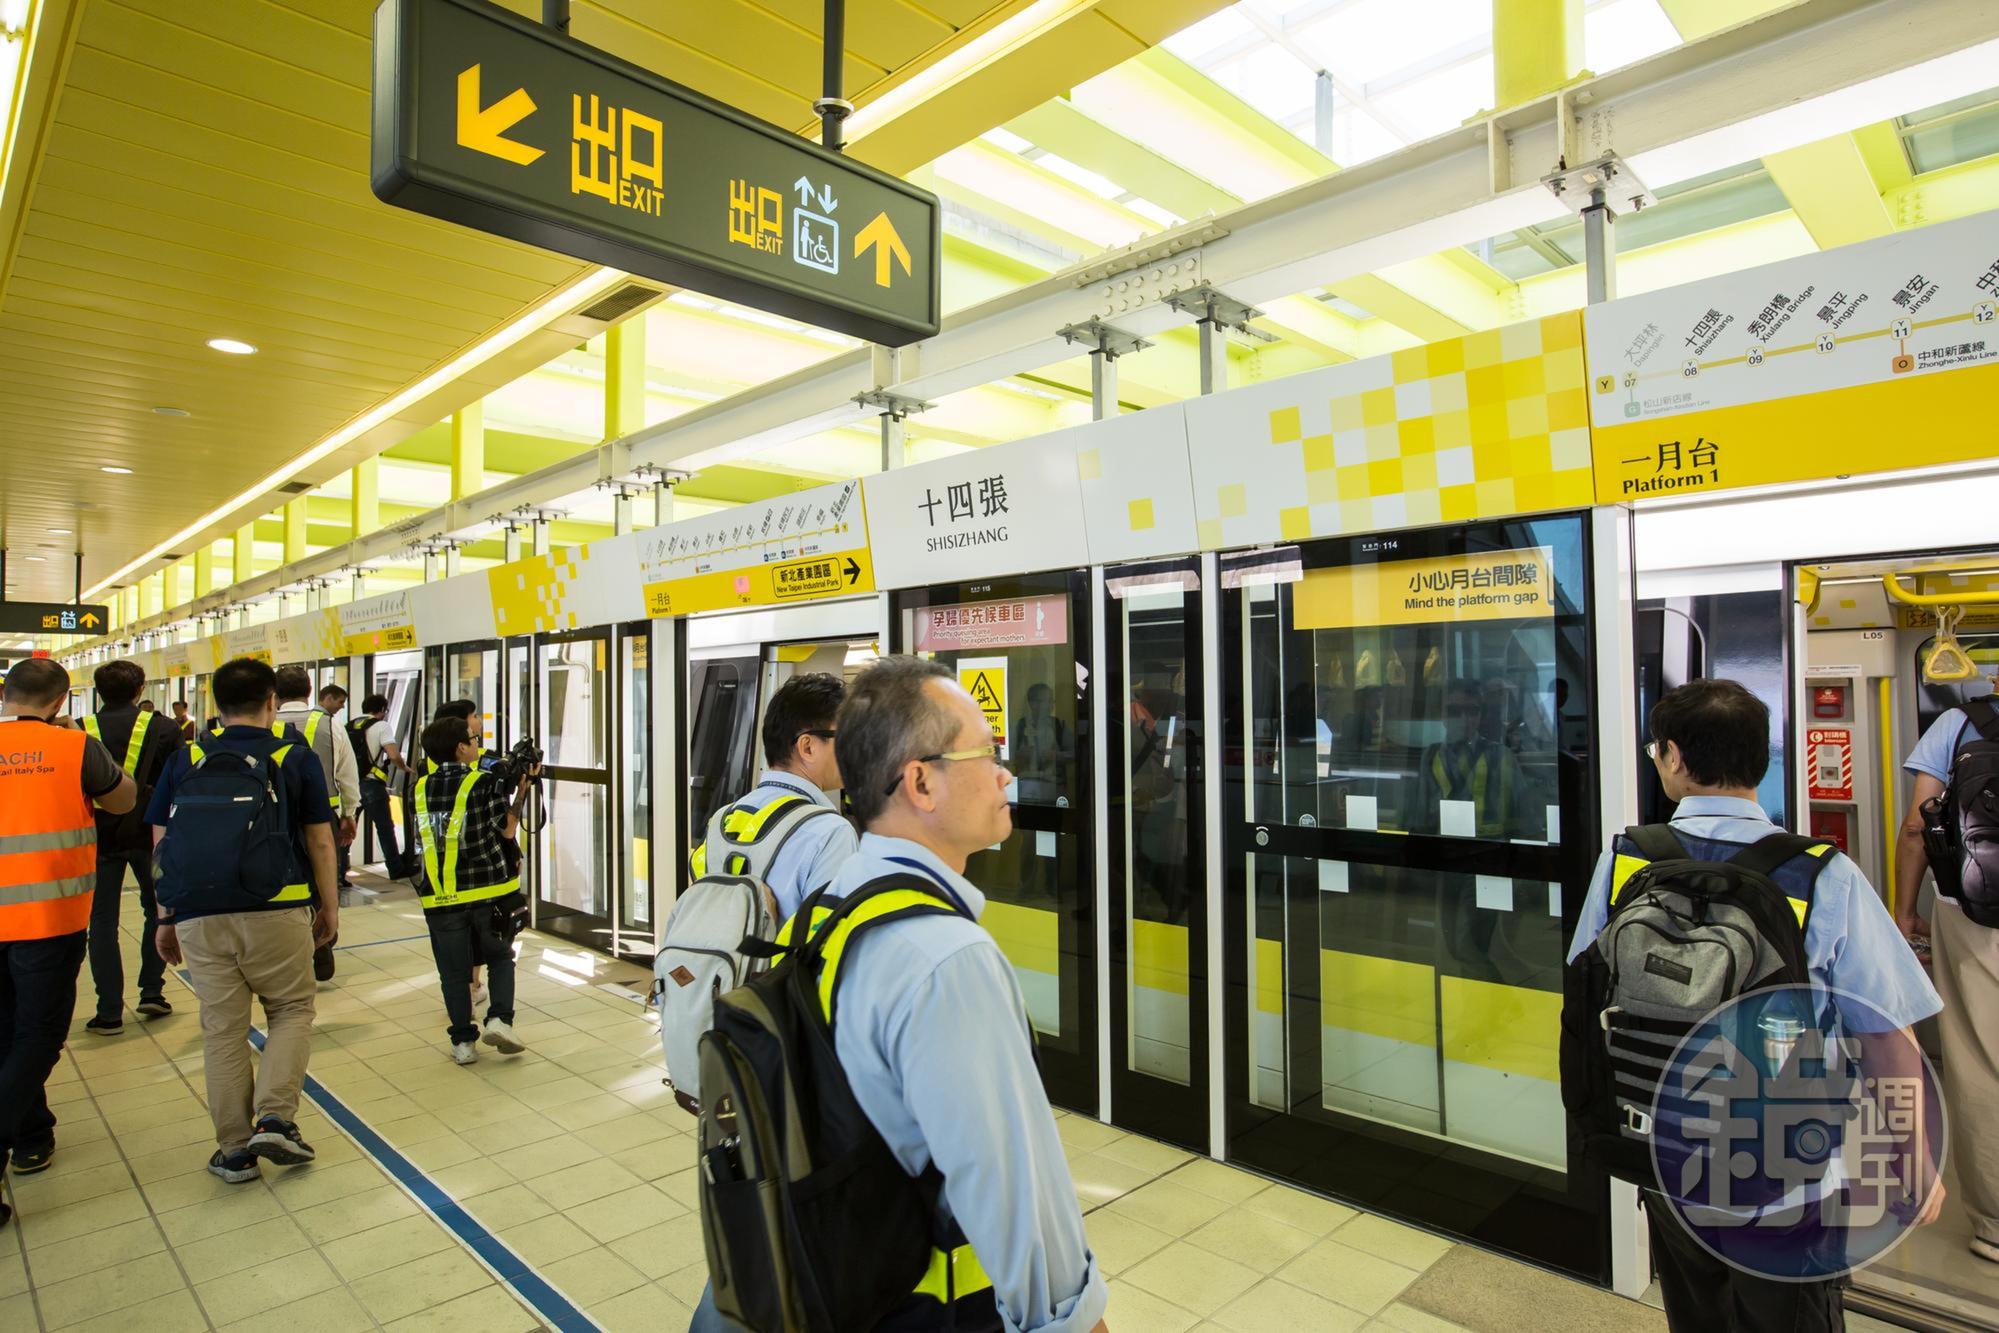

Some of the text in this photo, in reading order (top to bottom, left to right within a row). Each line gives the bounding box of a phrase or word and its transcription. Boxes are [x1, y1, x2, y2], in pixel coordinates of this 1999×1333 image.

[572, 93, 663, 205] 出口
[619, 180, 664, 216] EXIT
[729, 179, 783, 248] 出口
[756, 232, 783, 255] EXIT
[1892, 274, 1930, 308] 景安
[1909, 284, 1939, 315] Jingan
[1747, 293, 1791, 337] 秀朗橋
[1759, 285, 1815, 343] Xiulang Bridge
[1816, 291, 1848, 323] 景平
[1833, 293, 1869, 330] Jingping
[1977, 311, 1994, 322] 12
[1685, 308, 1723, 348] 十四張
[1694, 314, 1734, 356] Shisizhang
[1894, 328, 1908, 338] 11
[1624, 323, 1659, 362] 大坪林
[1818, 342, 1833, 351] 10
[1918, 341, 1985, 361] 中和新蘆線
[1684, 367, 1698, 376] 08
[1748, 355, 1763, 365] 09
[1898, 360, 1908, 369] O
[1918, 350, 1998, 369] Zhonghe-Xinlu Line
[1601, 380, 1609, 389] Y
[1624, 378, 1636, 388] 07
[1621, 438, 1719, 473] 一月台
[1623, 469, 1719, 494] Platform 1
[918, 474, 1009, 526] 十四張
[926, 526, 1009, 552] SHISIZHANG
[1383, 541, 1398, 550] 114
[803, 580, 826, 590] Industrial
[827, 579, 839, 587] Park
[1409, 563, 1538, 593] 小心月台間隙
[1405, 591, 1539, 609] Mind the platform gap
[933, 603, 1025, 628] 孕婦優先候車區
[933, 629, 953, 639] Priority
[970, 635, 1000, 645] expectant
[1863, 632, 1883, 640] L05
[15, 767, 34, 775] Italy
[37, 765, 55, 773] Spa
